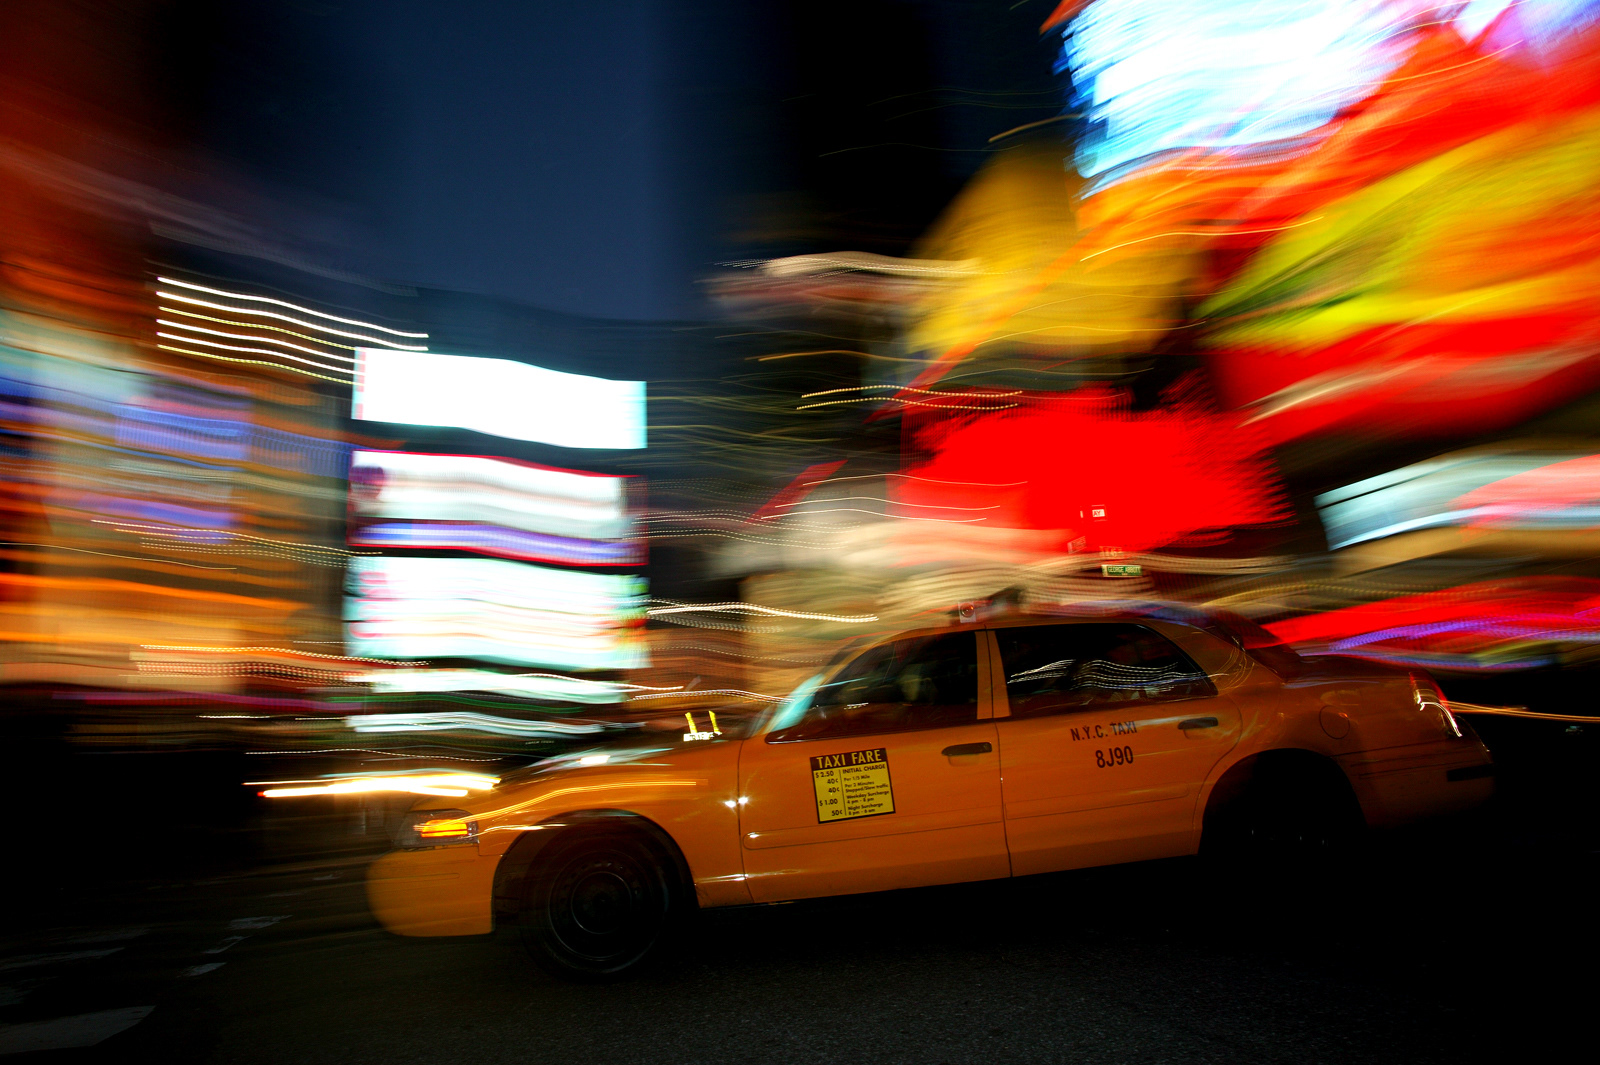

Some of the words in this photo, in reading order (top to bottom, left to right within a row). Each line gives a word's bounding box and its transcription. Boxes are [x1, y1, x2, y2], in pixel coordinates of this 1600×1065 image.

[1070, 724, 1108, 741] N.Y.C.
[1110, 721, 1138, 736] TAXI
[816, 754, 846, 768] TAXI
[851, 750, 882, 764] FARE
[1095, 746, 1134, 768] 8J90
